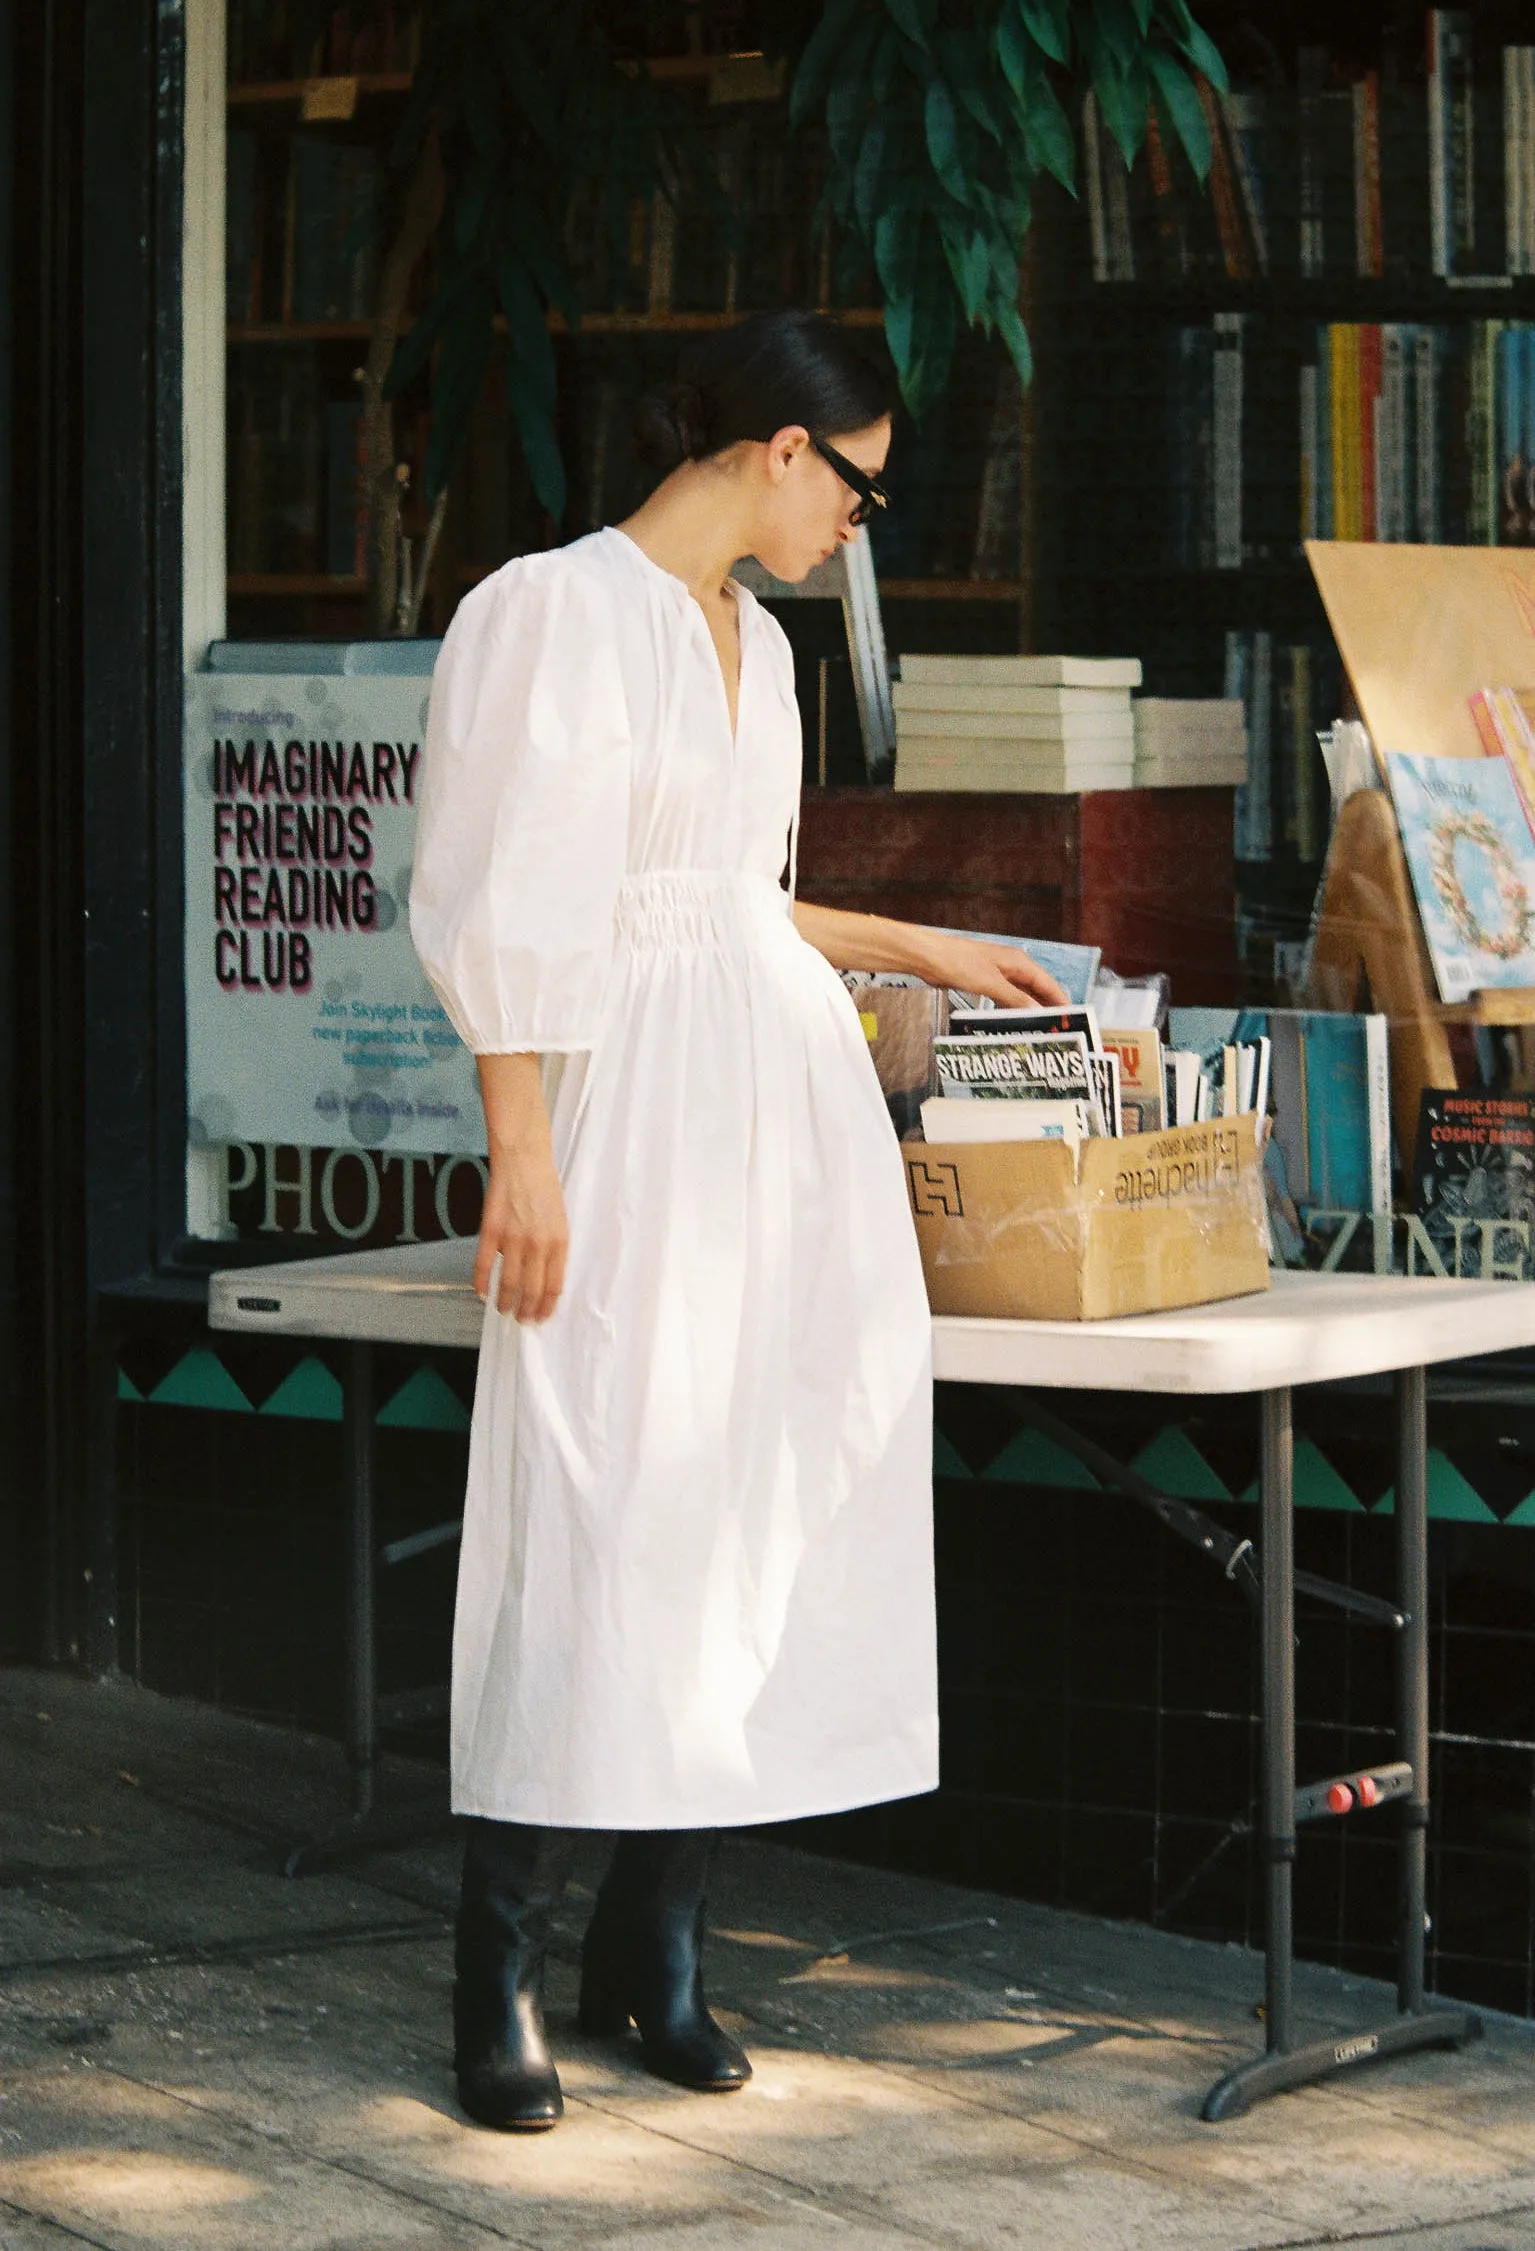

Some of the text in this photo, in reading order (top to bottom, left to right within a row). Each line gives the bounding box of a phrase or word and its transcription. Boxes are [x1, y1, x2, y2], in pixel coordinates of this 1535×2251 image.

[214, 738, 420, 804] IMAGINARY
[214, 802, 374, 868] FRIENDS
[214, 866, 379, 932] READING
[214, 928, 313, 995] CLUB
[935, 1050, 1086, 1082] STRANGE WAYS
[1271, 1206, 1529, 1280] ZINE
